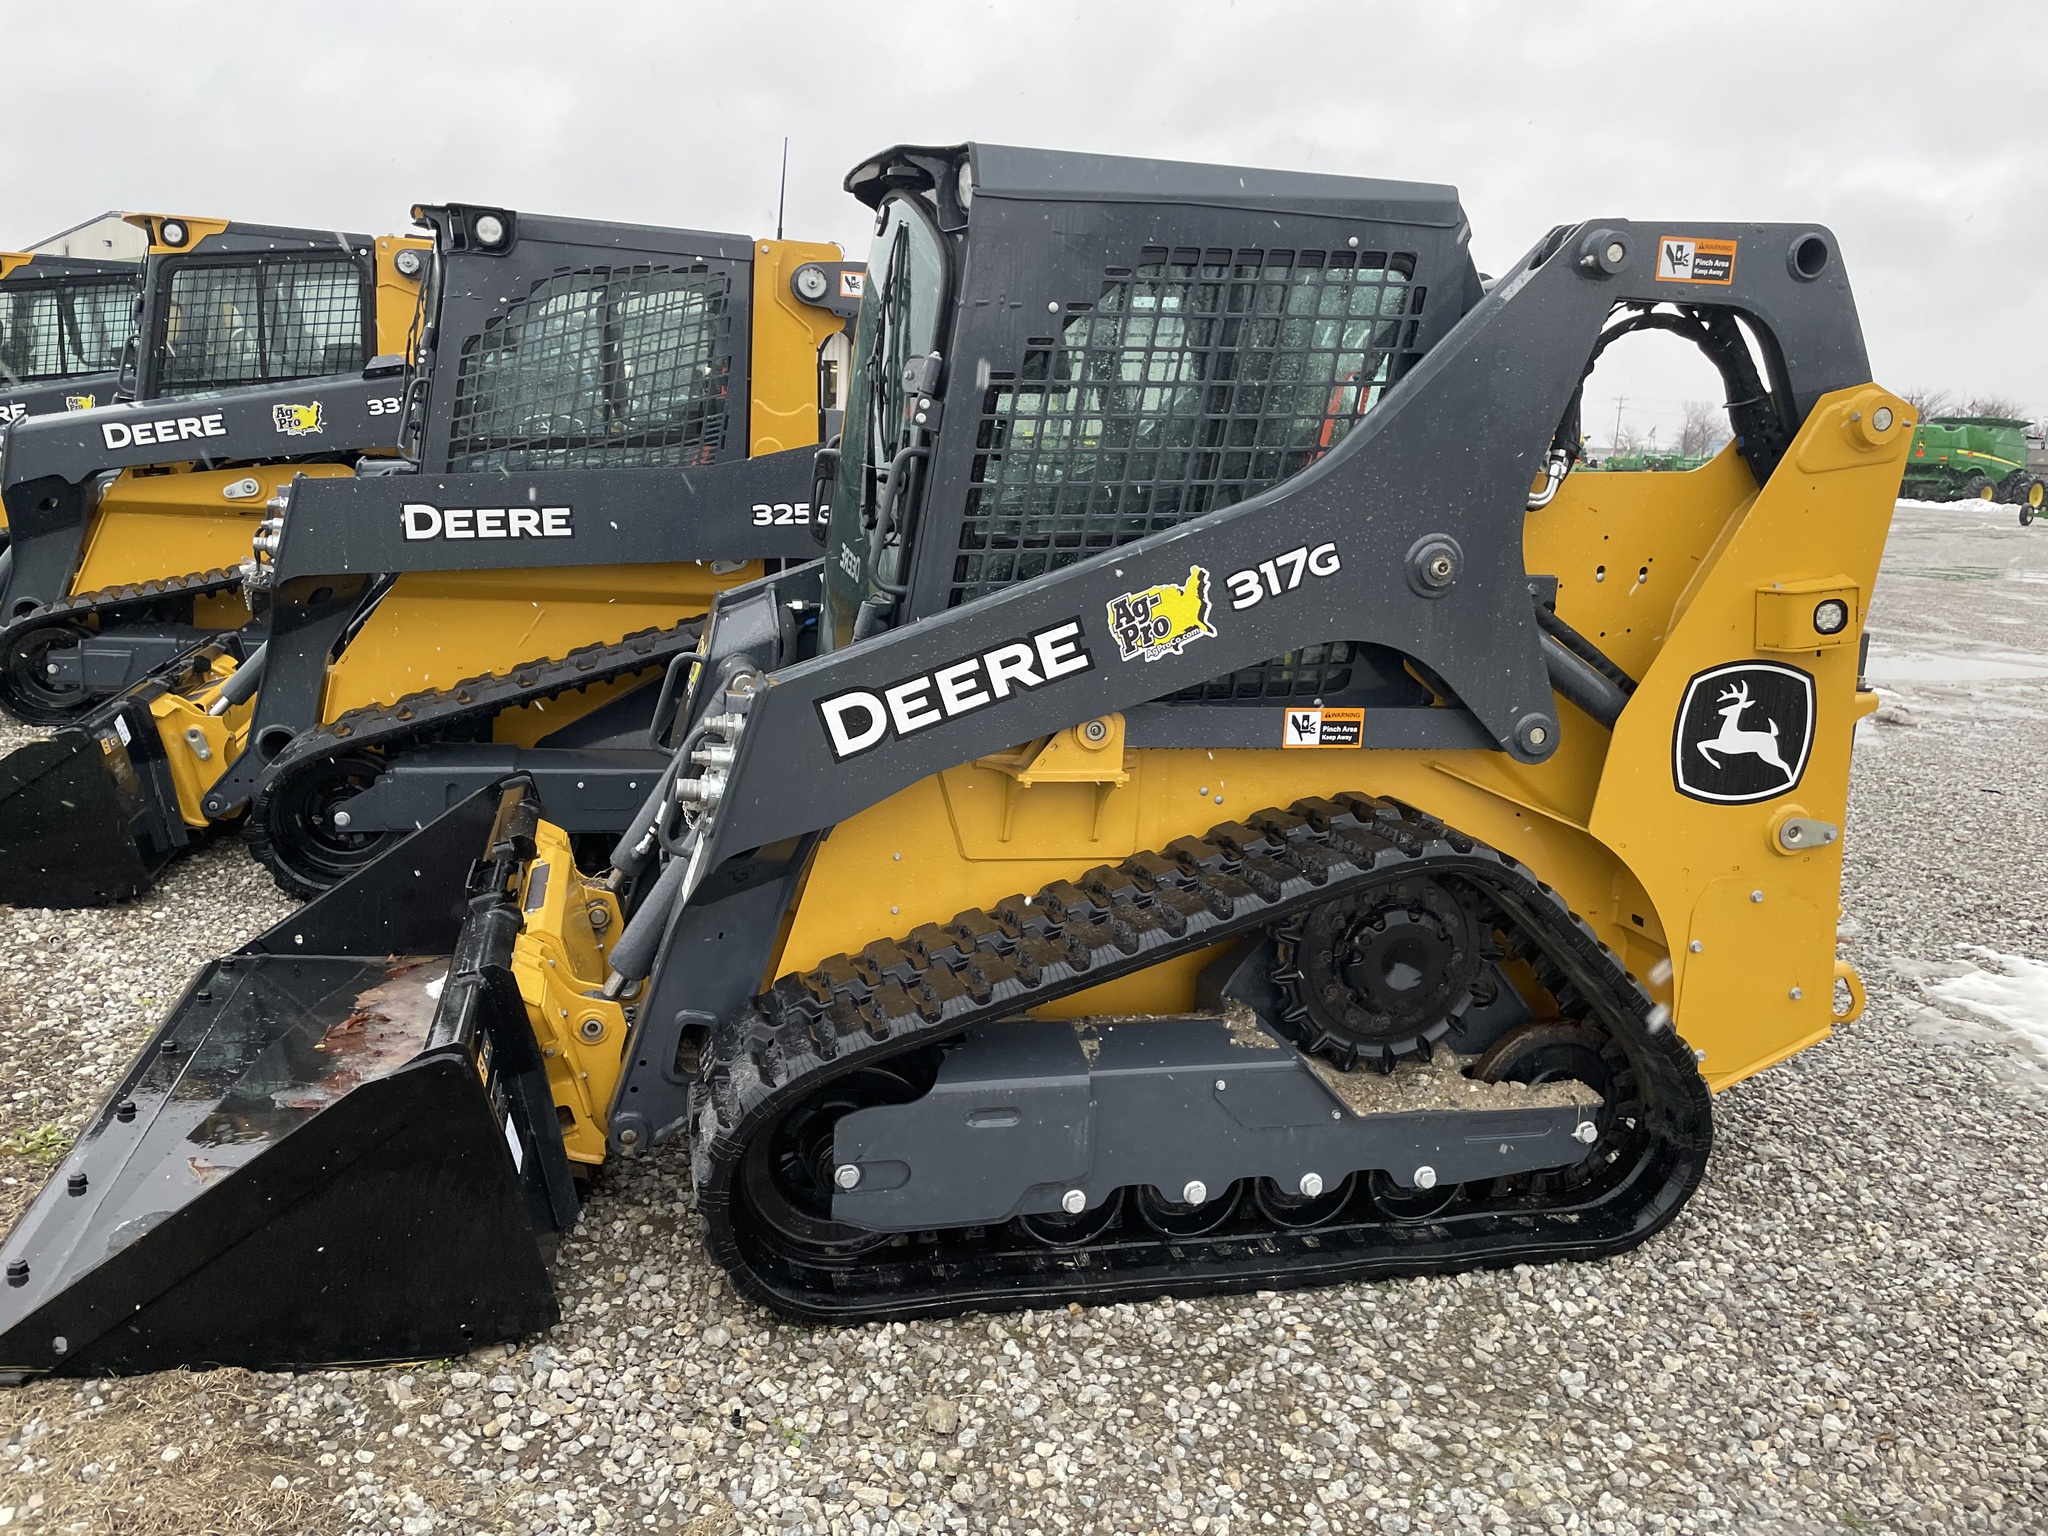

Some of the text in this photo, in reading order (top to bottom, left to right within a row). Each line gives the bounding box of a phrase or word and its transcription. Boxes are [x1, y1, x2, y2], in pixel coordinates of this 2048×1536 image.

[1704, 244, 1732, 252] WARNING
[1693, 267, 1724, 277] Keep Away
[1694, 258, 1730, 268] Pinch Area
[276, 407, 298, 419] Ag-
[278, 418, 301, 429] Pro
[101, 413, 227, 450] DEERE
[403, 504, 572, 540] DEERE
[1226, 542, 1341, 610] 317G
[1112, 593, 1161, 631] Ag-
[1118, 617, 1170, 655] Pro
[1146, 628, 1201, 659] AgProCo.com
[820, 621, 1089, 757] DEERE
[1321, 734, 1353, 742] Keep Away
[1322, 725, 1358, 733] Pinch Area
